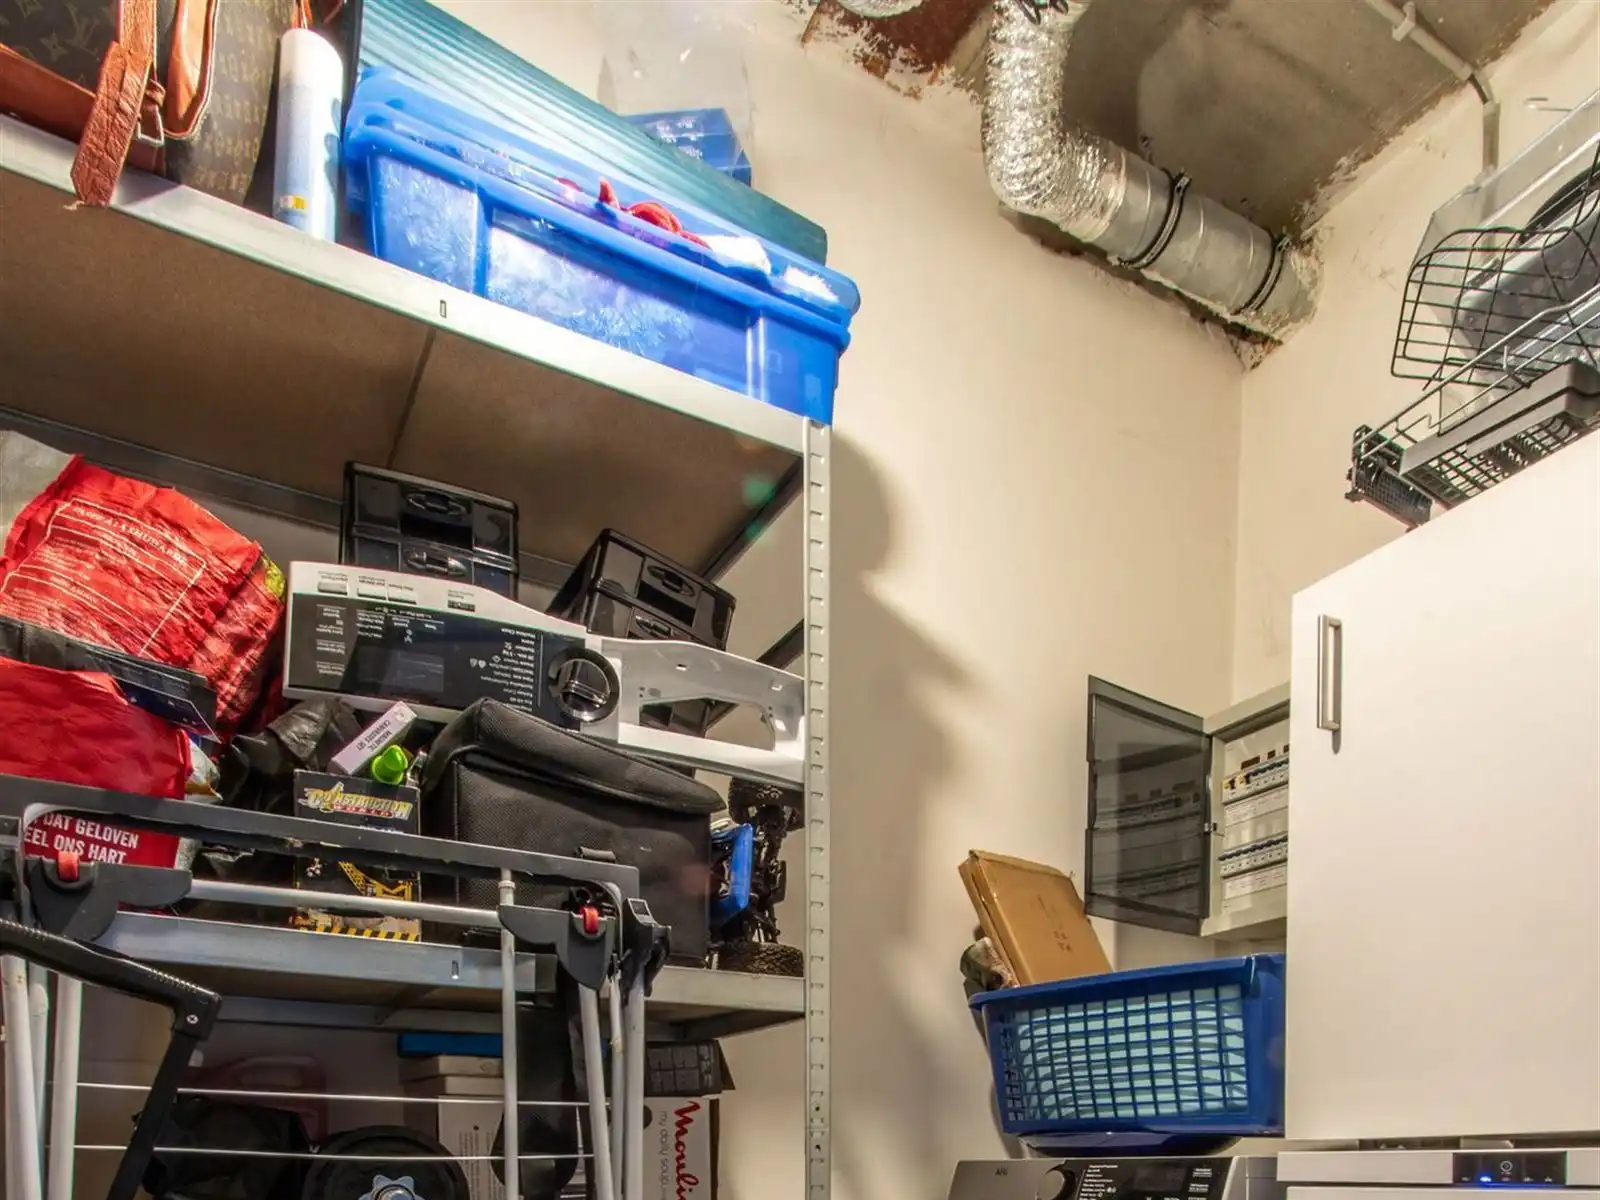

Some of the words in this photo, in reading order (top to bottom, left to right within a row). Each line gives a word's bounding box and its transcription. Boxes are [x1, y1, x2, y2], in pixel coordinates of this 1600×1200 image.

[75, 818, 140, 849] GELOVEN
[53, 834, 85, 857] ONS
[87, 843, 128, 864] HART
